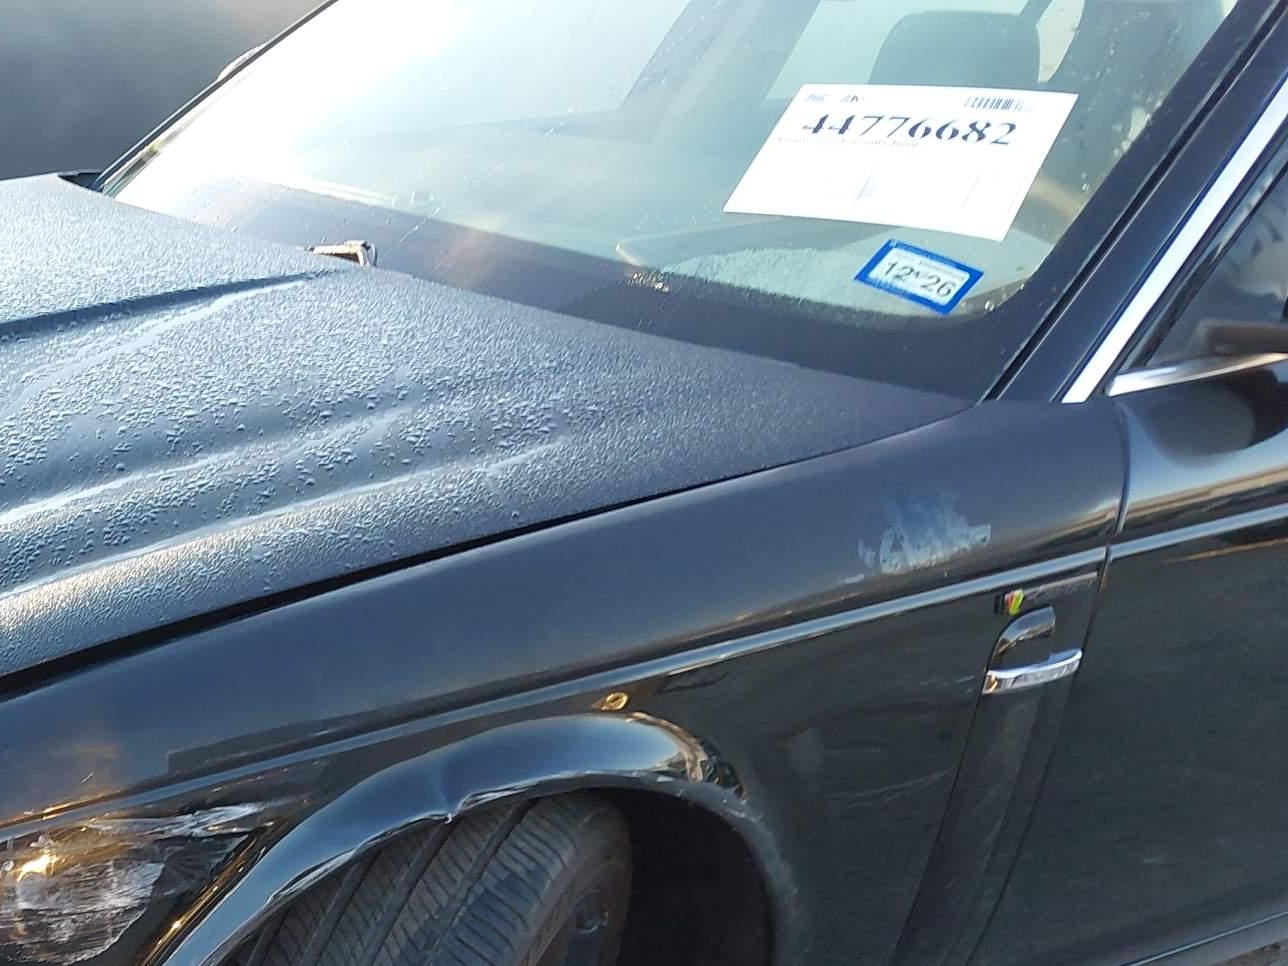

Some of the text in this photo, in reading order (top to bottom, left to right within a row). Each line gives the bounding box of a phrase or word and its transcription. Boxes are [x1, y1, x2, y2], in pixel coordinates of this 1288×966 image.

[802, 113, 1017, 146] 44776682
[884, 261, 914, 282] 12
[921, 274, 957, 298] 26
